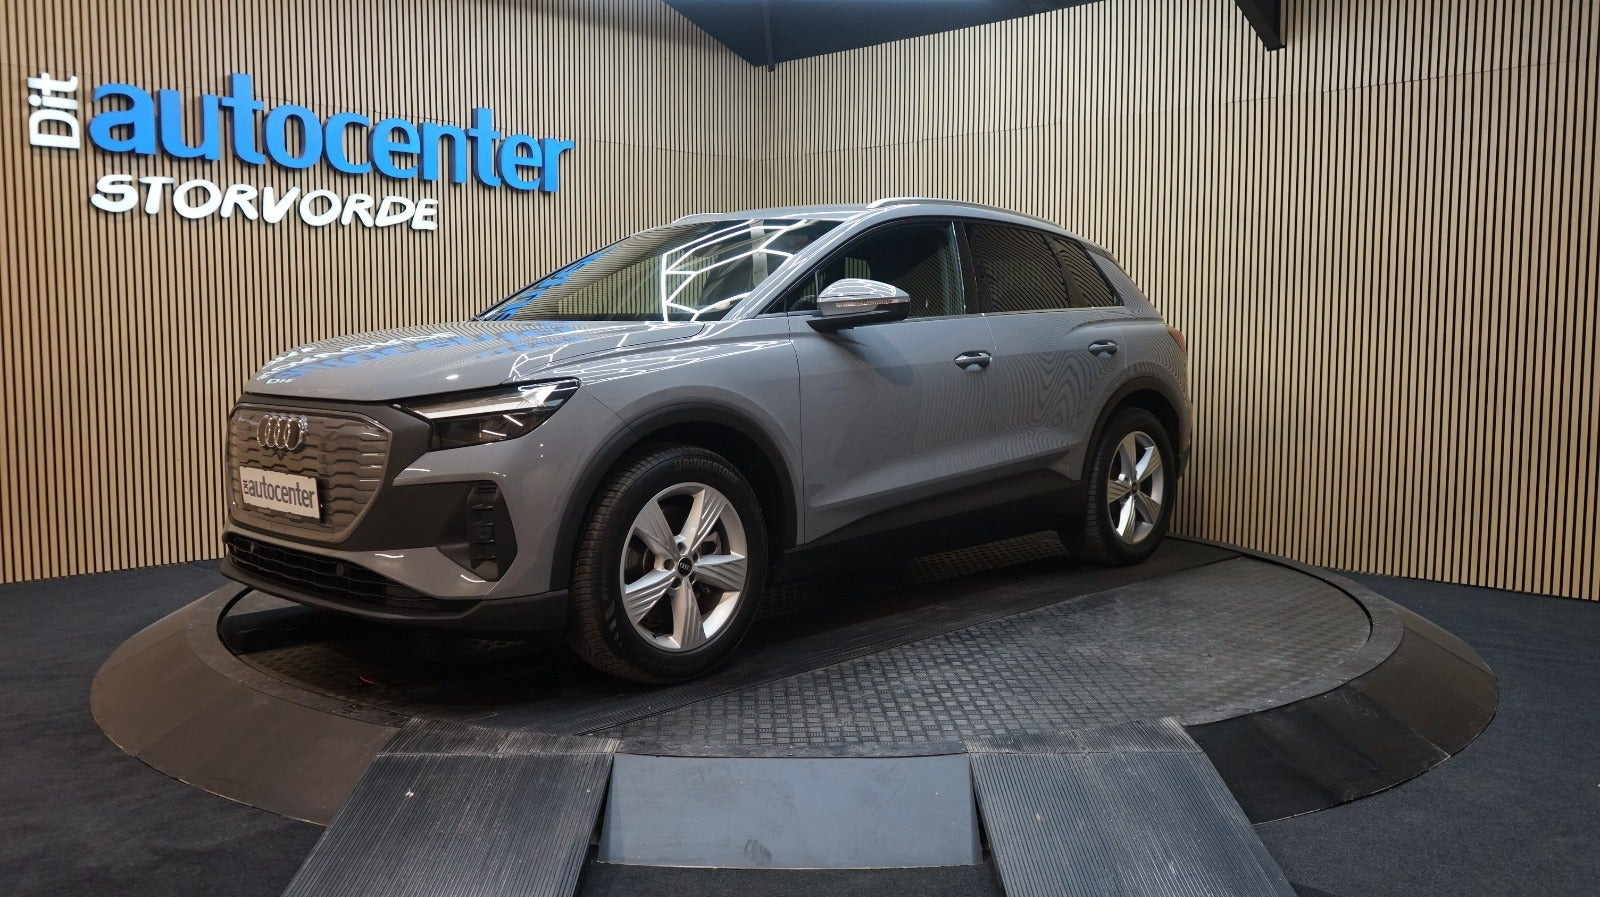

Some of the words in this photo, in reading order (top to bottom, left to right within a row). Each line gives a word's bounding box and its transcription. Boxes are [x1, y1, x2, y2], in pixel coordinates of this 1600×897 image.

[27, 72, 81, 149] Dit
[90, 73, 575, 193] autocenter
[90, 173, 438, 231] STORVORDE
[249, 475, 315, 508] autocenter
